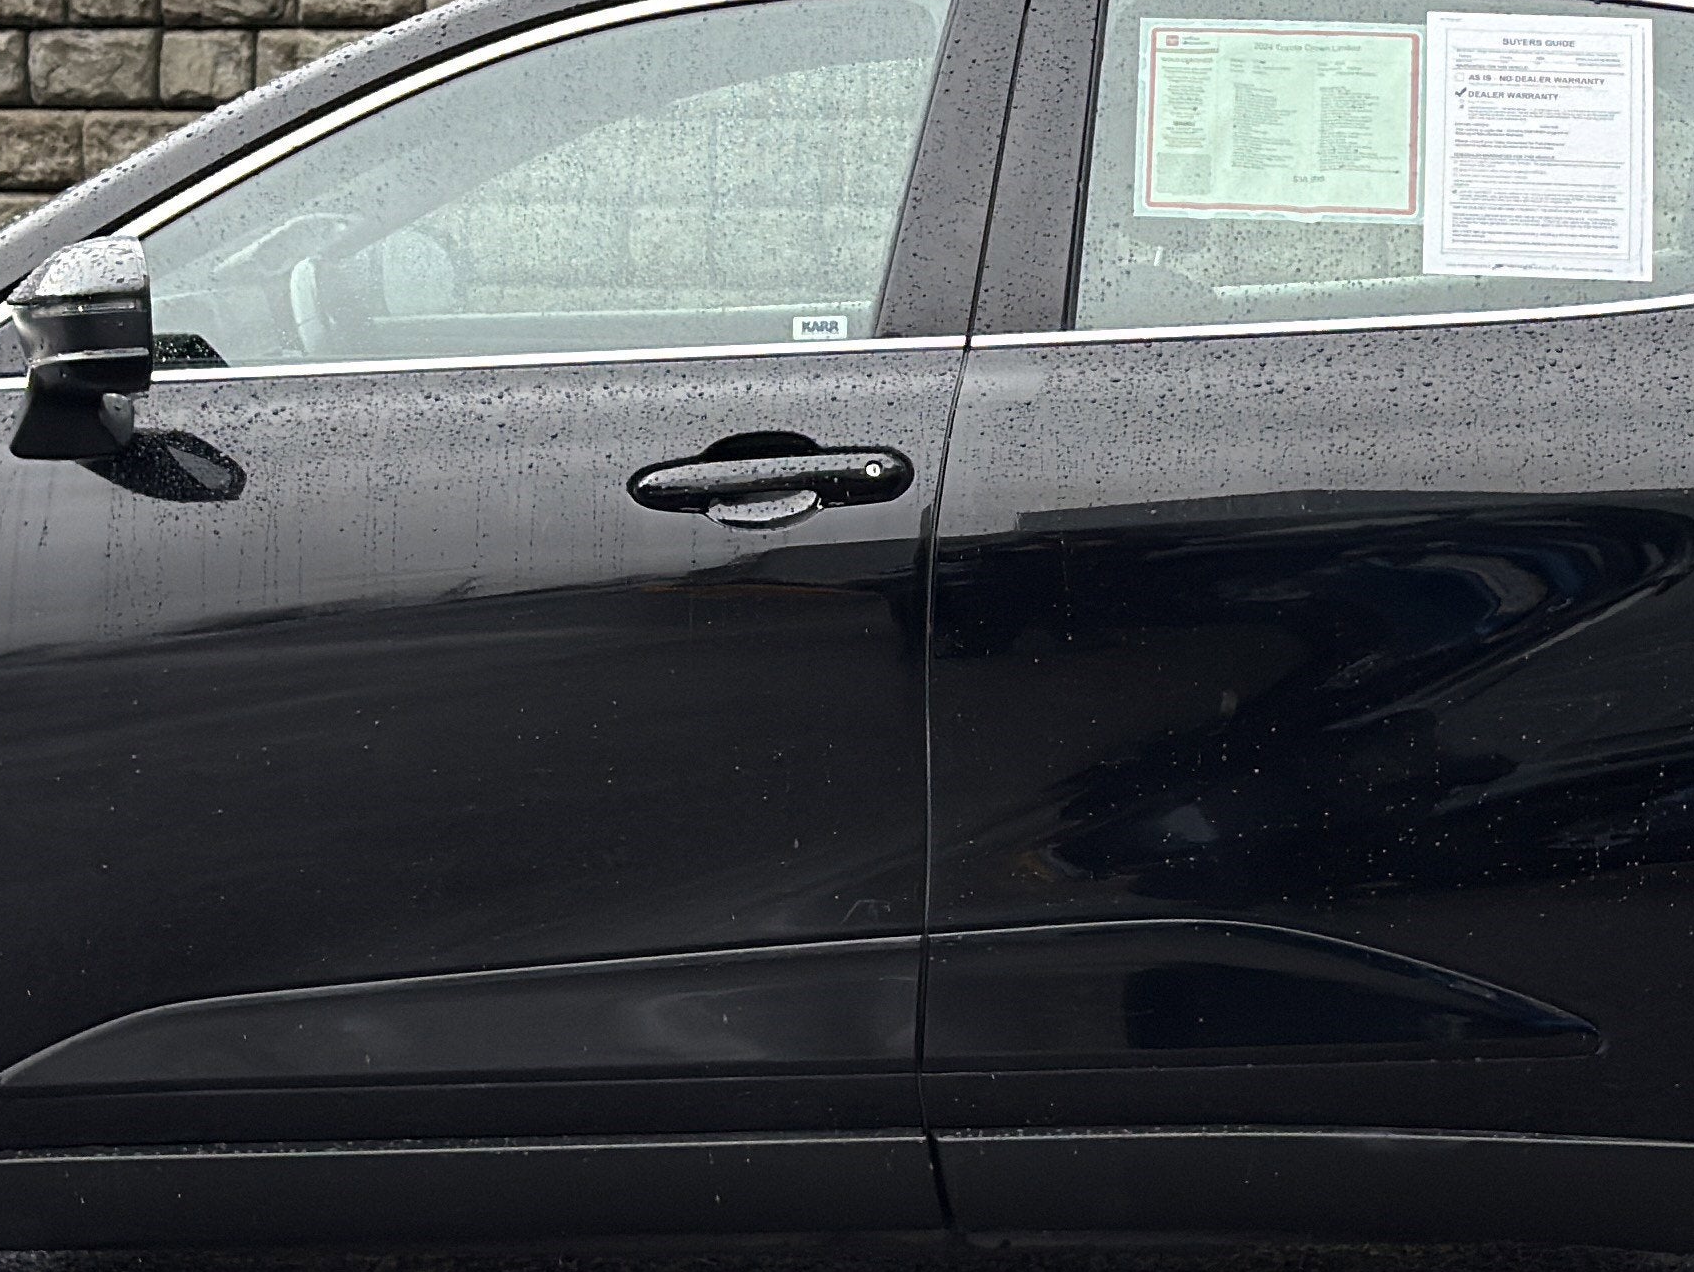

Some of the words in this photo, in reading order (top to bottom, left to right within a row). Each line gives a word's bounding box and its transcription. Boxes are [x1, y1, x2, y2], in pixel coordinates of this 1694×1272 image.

[1502, 38, 1542, 46] BUYERS
[1545, 40, 1576, 48] GUIDE
[1516, 75, 1551, 83] DEALER
[1554, 76, 1605, 85] WARRANTY
[1507, 92, 1559, 100] WARRANTY
[801, 320, 839, 333] KARR
